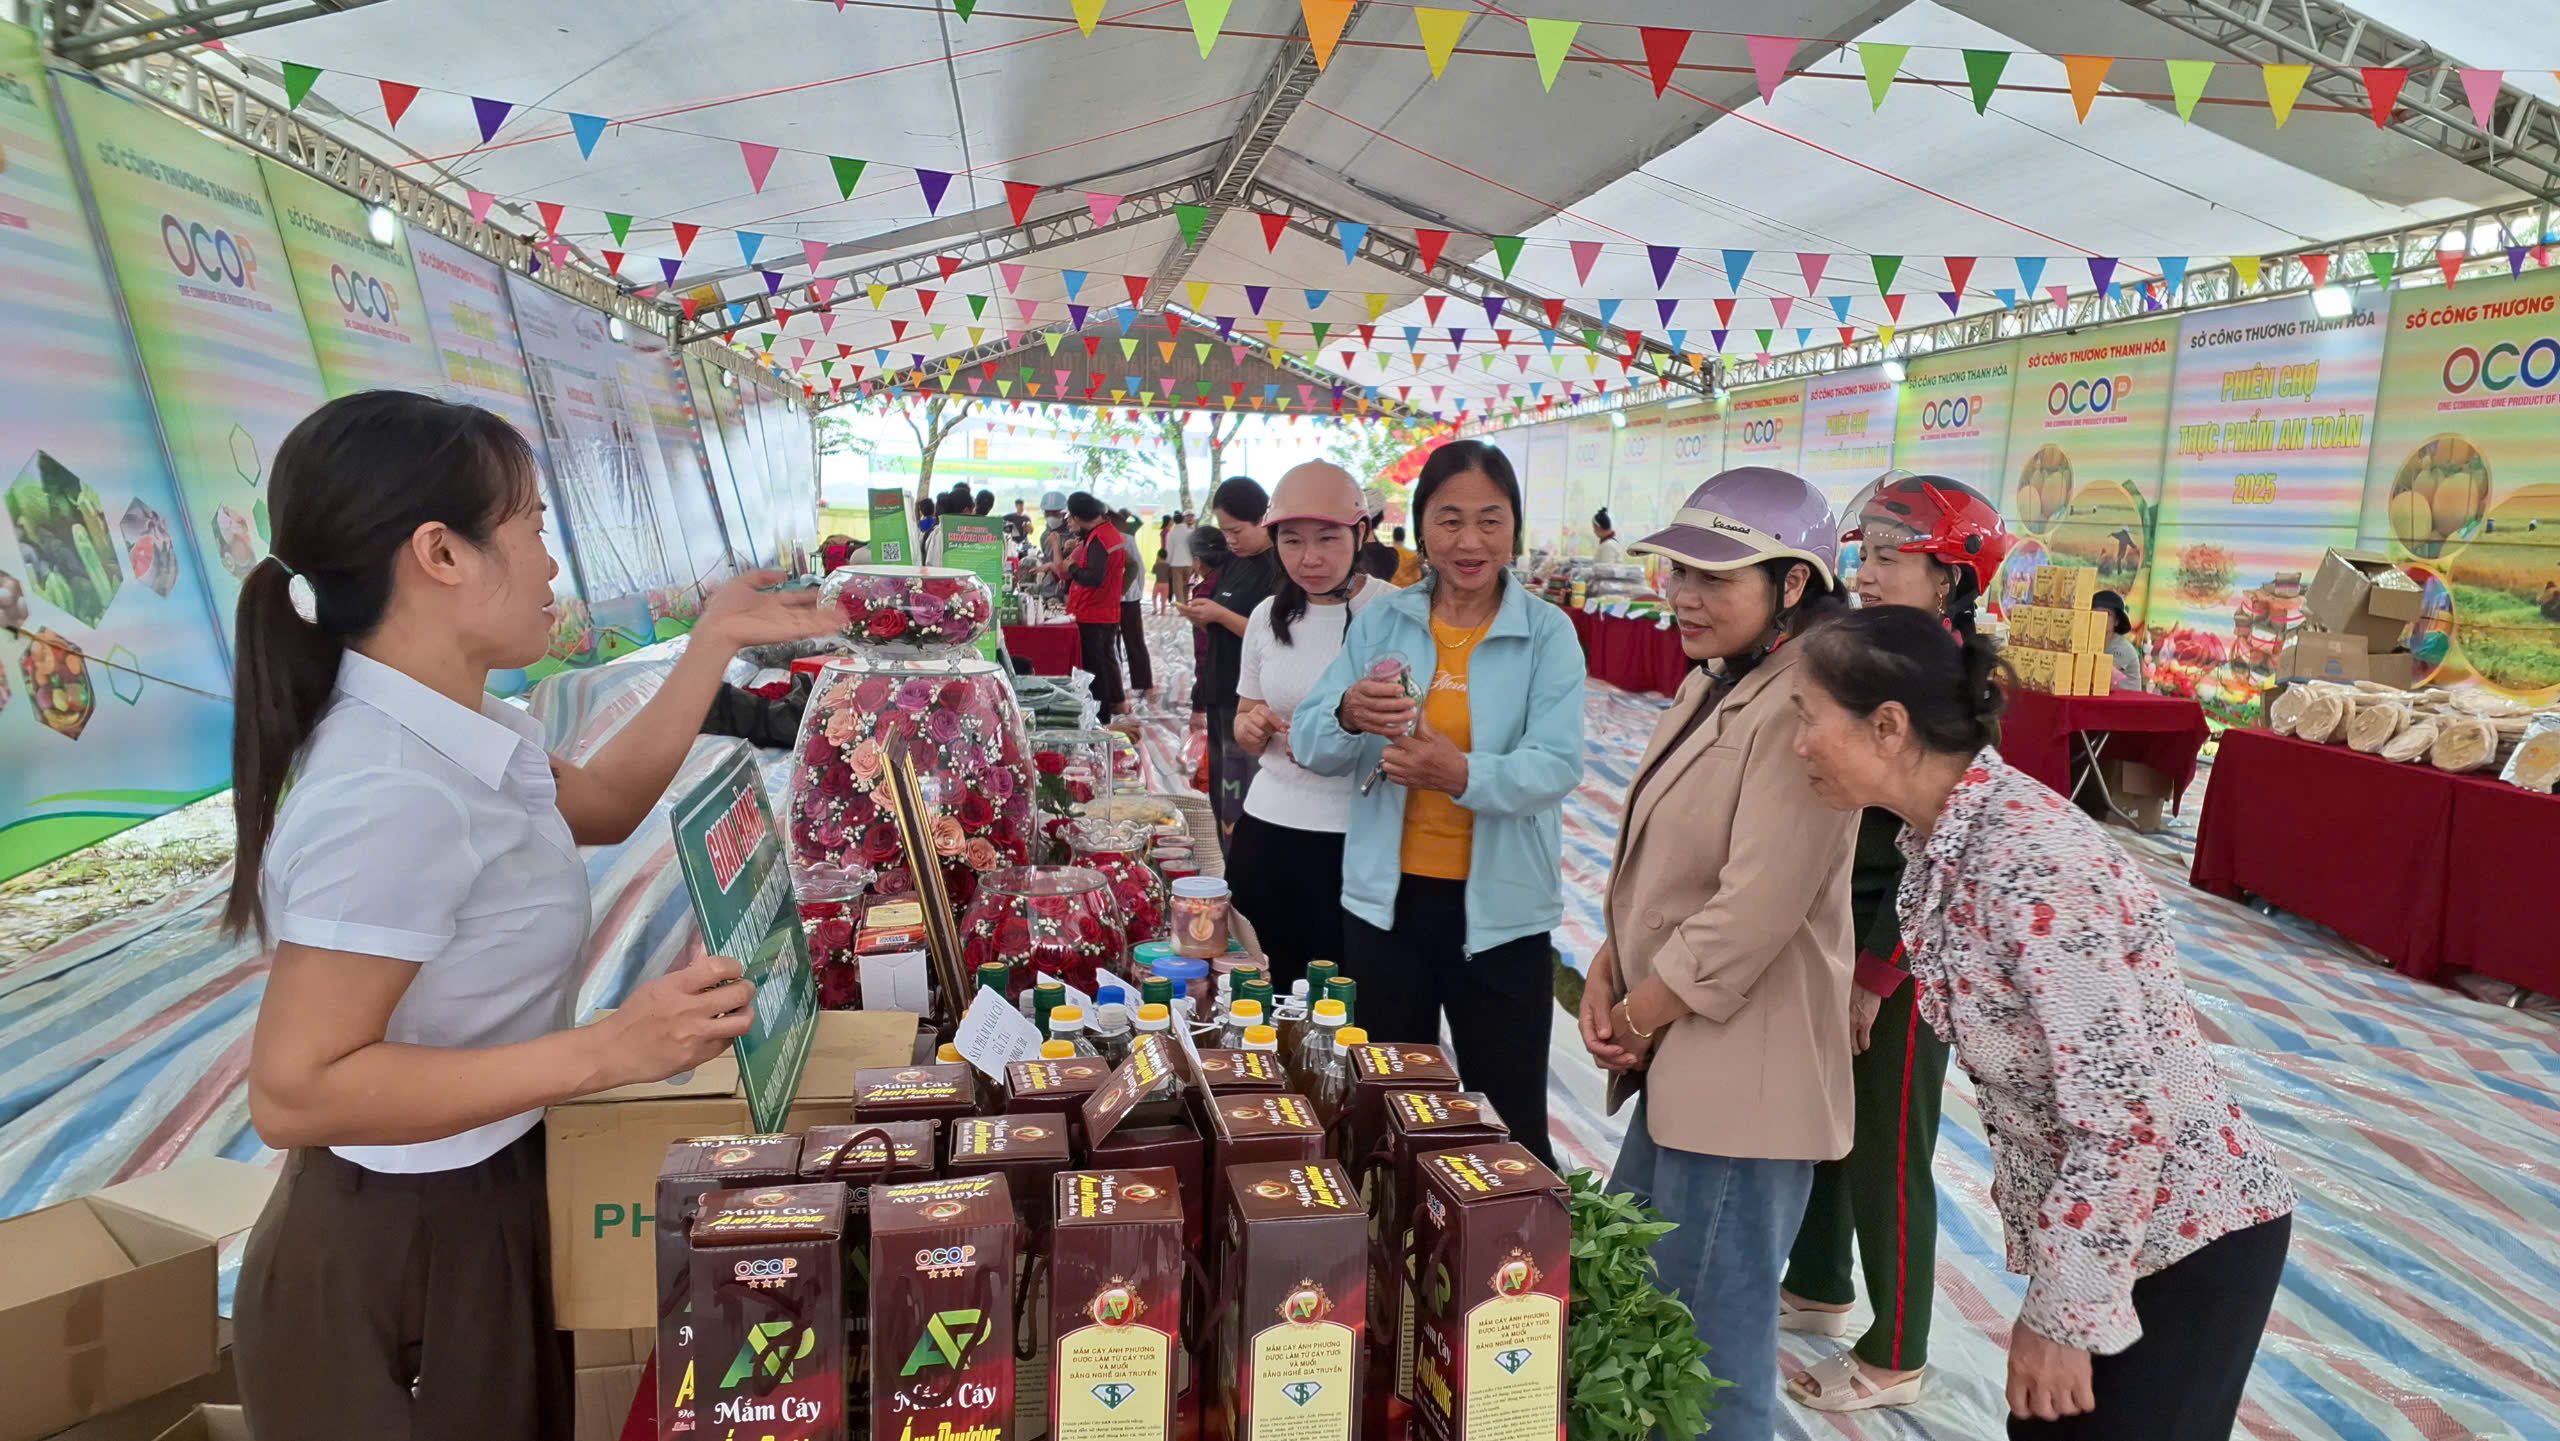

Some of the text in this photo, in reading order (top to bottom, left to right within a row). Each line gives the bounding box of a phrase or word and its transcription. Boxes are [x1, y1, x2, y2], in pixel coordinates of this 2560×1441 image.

[161, 214, 257, 291] OCOP
[331, 264, 399, 327] OCOP
[2405, 296, 2555, 329] SỞ CÔNG THƯƠNG
[2190, 331, 2206, 349] SỞ
[2208, 329, 2242, 346] CÔNG
[2245, 322, 2296, 342] THƯƠNG
[2347, 309, 2376, 328] HÓA
[2028, 338, 2166, 368] SỞ CÔNG THƯƠNG THANH HÓA
[1967, 367, 1991, 380] THANH
[2221, 359, 2320, 402] PHIÊN CHỢ
[2048, 375, 2134, 416] OCOP
[2507, 395, 2544, 407] PRODUCT
[1922, 395, 1983, 430] OCOP
[1744, 417, 1784, 444] OCOP
[2179, 408, 2364, 461] THỰC PHẨM AN TOÀN
[2232, 473, 2277, 504] 2025
[1711, 516, 1751, 534] Vespa
[704, 806, 744, 896] GIAN
[730, 782, 766, 863] HÀNG
[594, 1202, 656, 1239] PH
[734, 1257, 797, 1276] OCOP
[915, 1245, 976, 1266] OCOP
[1514, 1337, 1525, 1345] GIA
[1304, 1368, 1315, 1376] GIA
[713, 1396, 822, 1424] Mắm Cáy
[959, 1383, 997, 1410] Cáy
